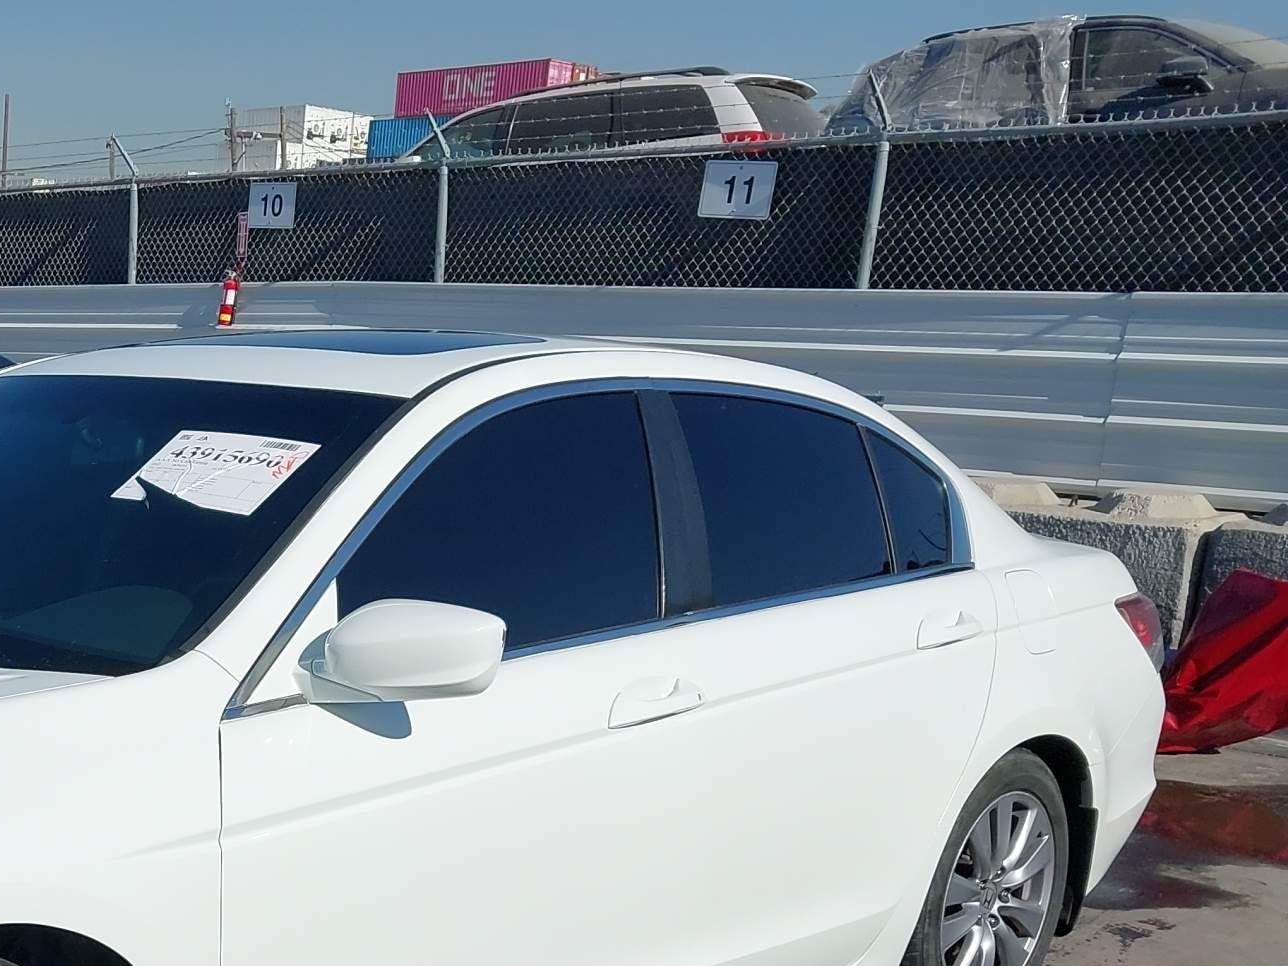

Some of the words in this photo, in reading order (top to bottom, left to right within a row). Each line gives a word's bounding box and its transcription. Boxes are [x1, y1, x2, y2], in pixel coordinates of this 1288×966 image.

[442, 72, 495, 100] ONE
[724, 175, 755, 205] 11
[260, 193, 283, 217] 10
[169, 444, 285, 470] 43915690
